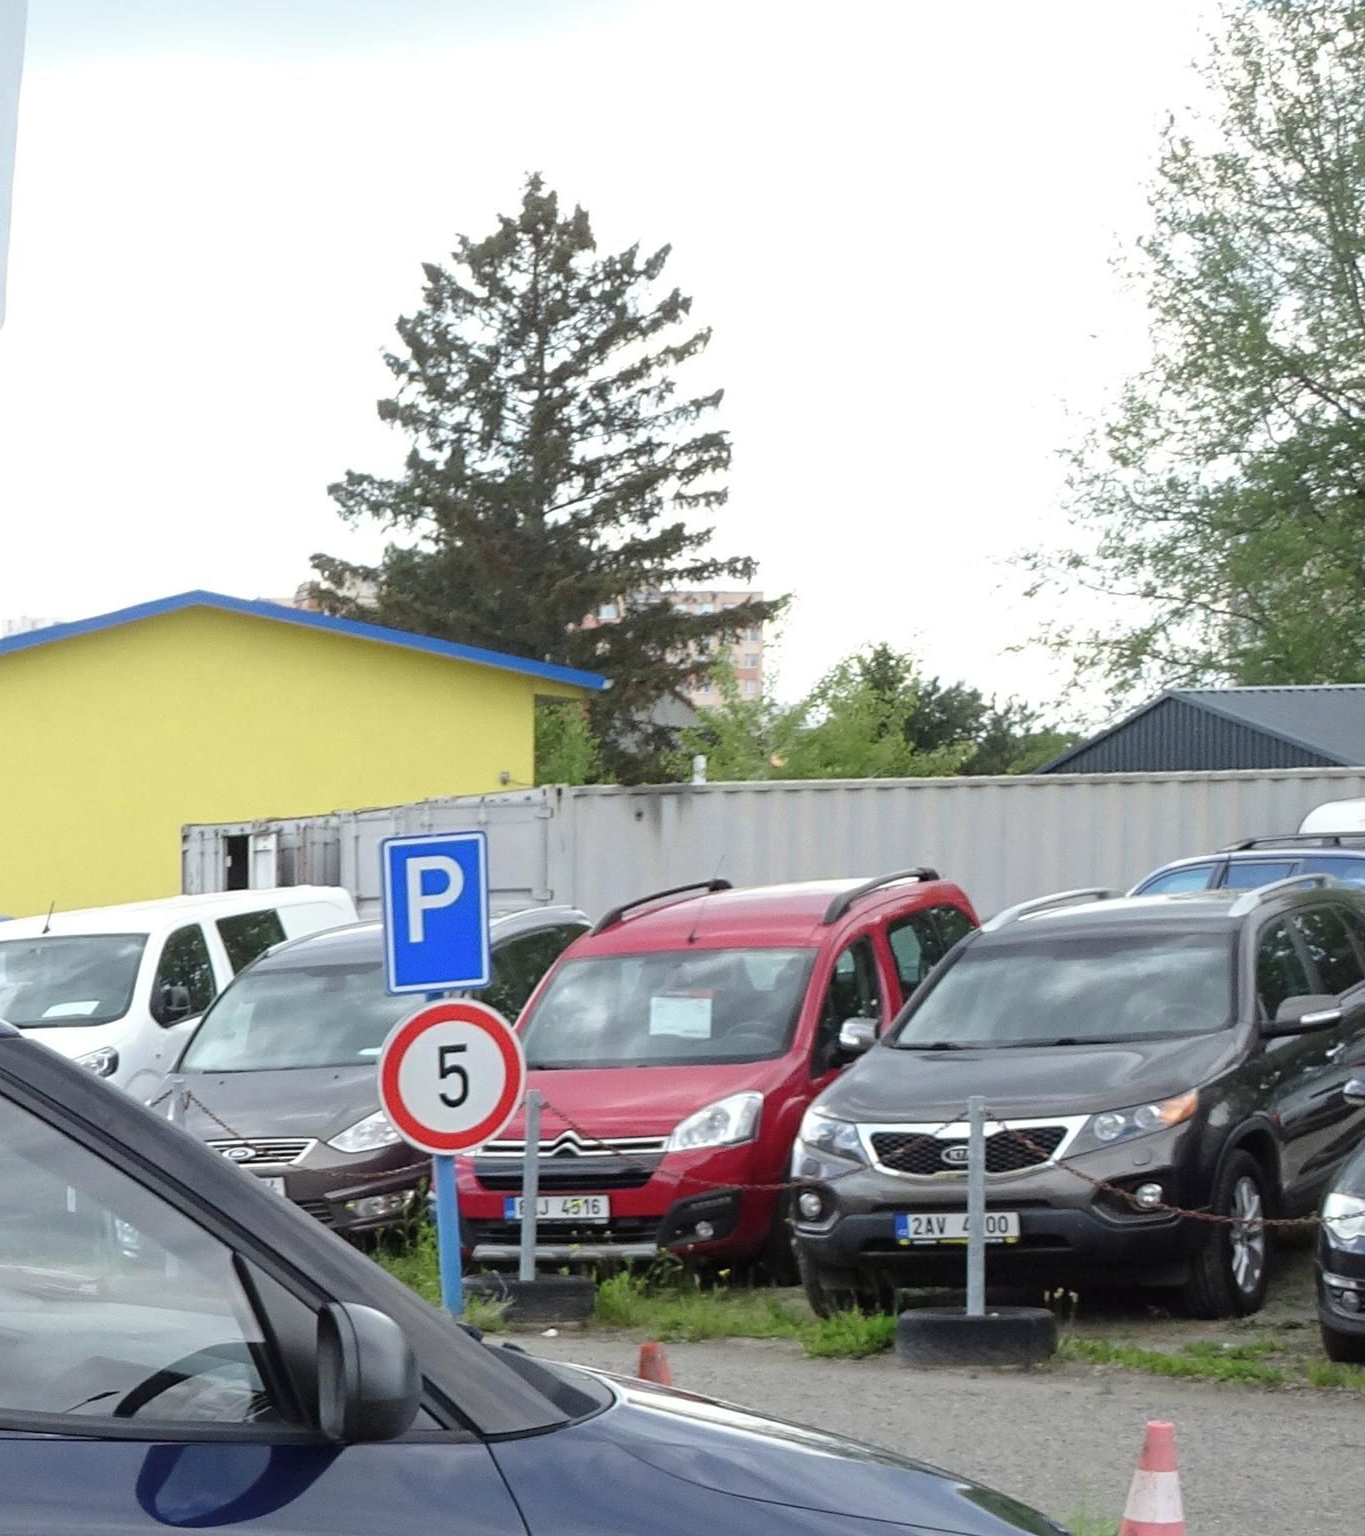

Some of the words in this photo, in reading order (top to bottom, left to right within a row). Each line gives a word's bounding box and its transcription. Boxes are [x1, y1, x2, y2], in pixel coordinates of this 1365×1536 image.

[405, 855, 465, 944] P
[436, 1043, 470, 1108] 5
[911, 1216, 948, 1236] 2AV
[961, 1215, 1009, 1234] 400
